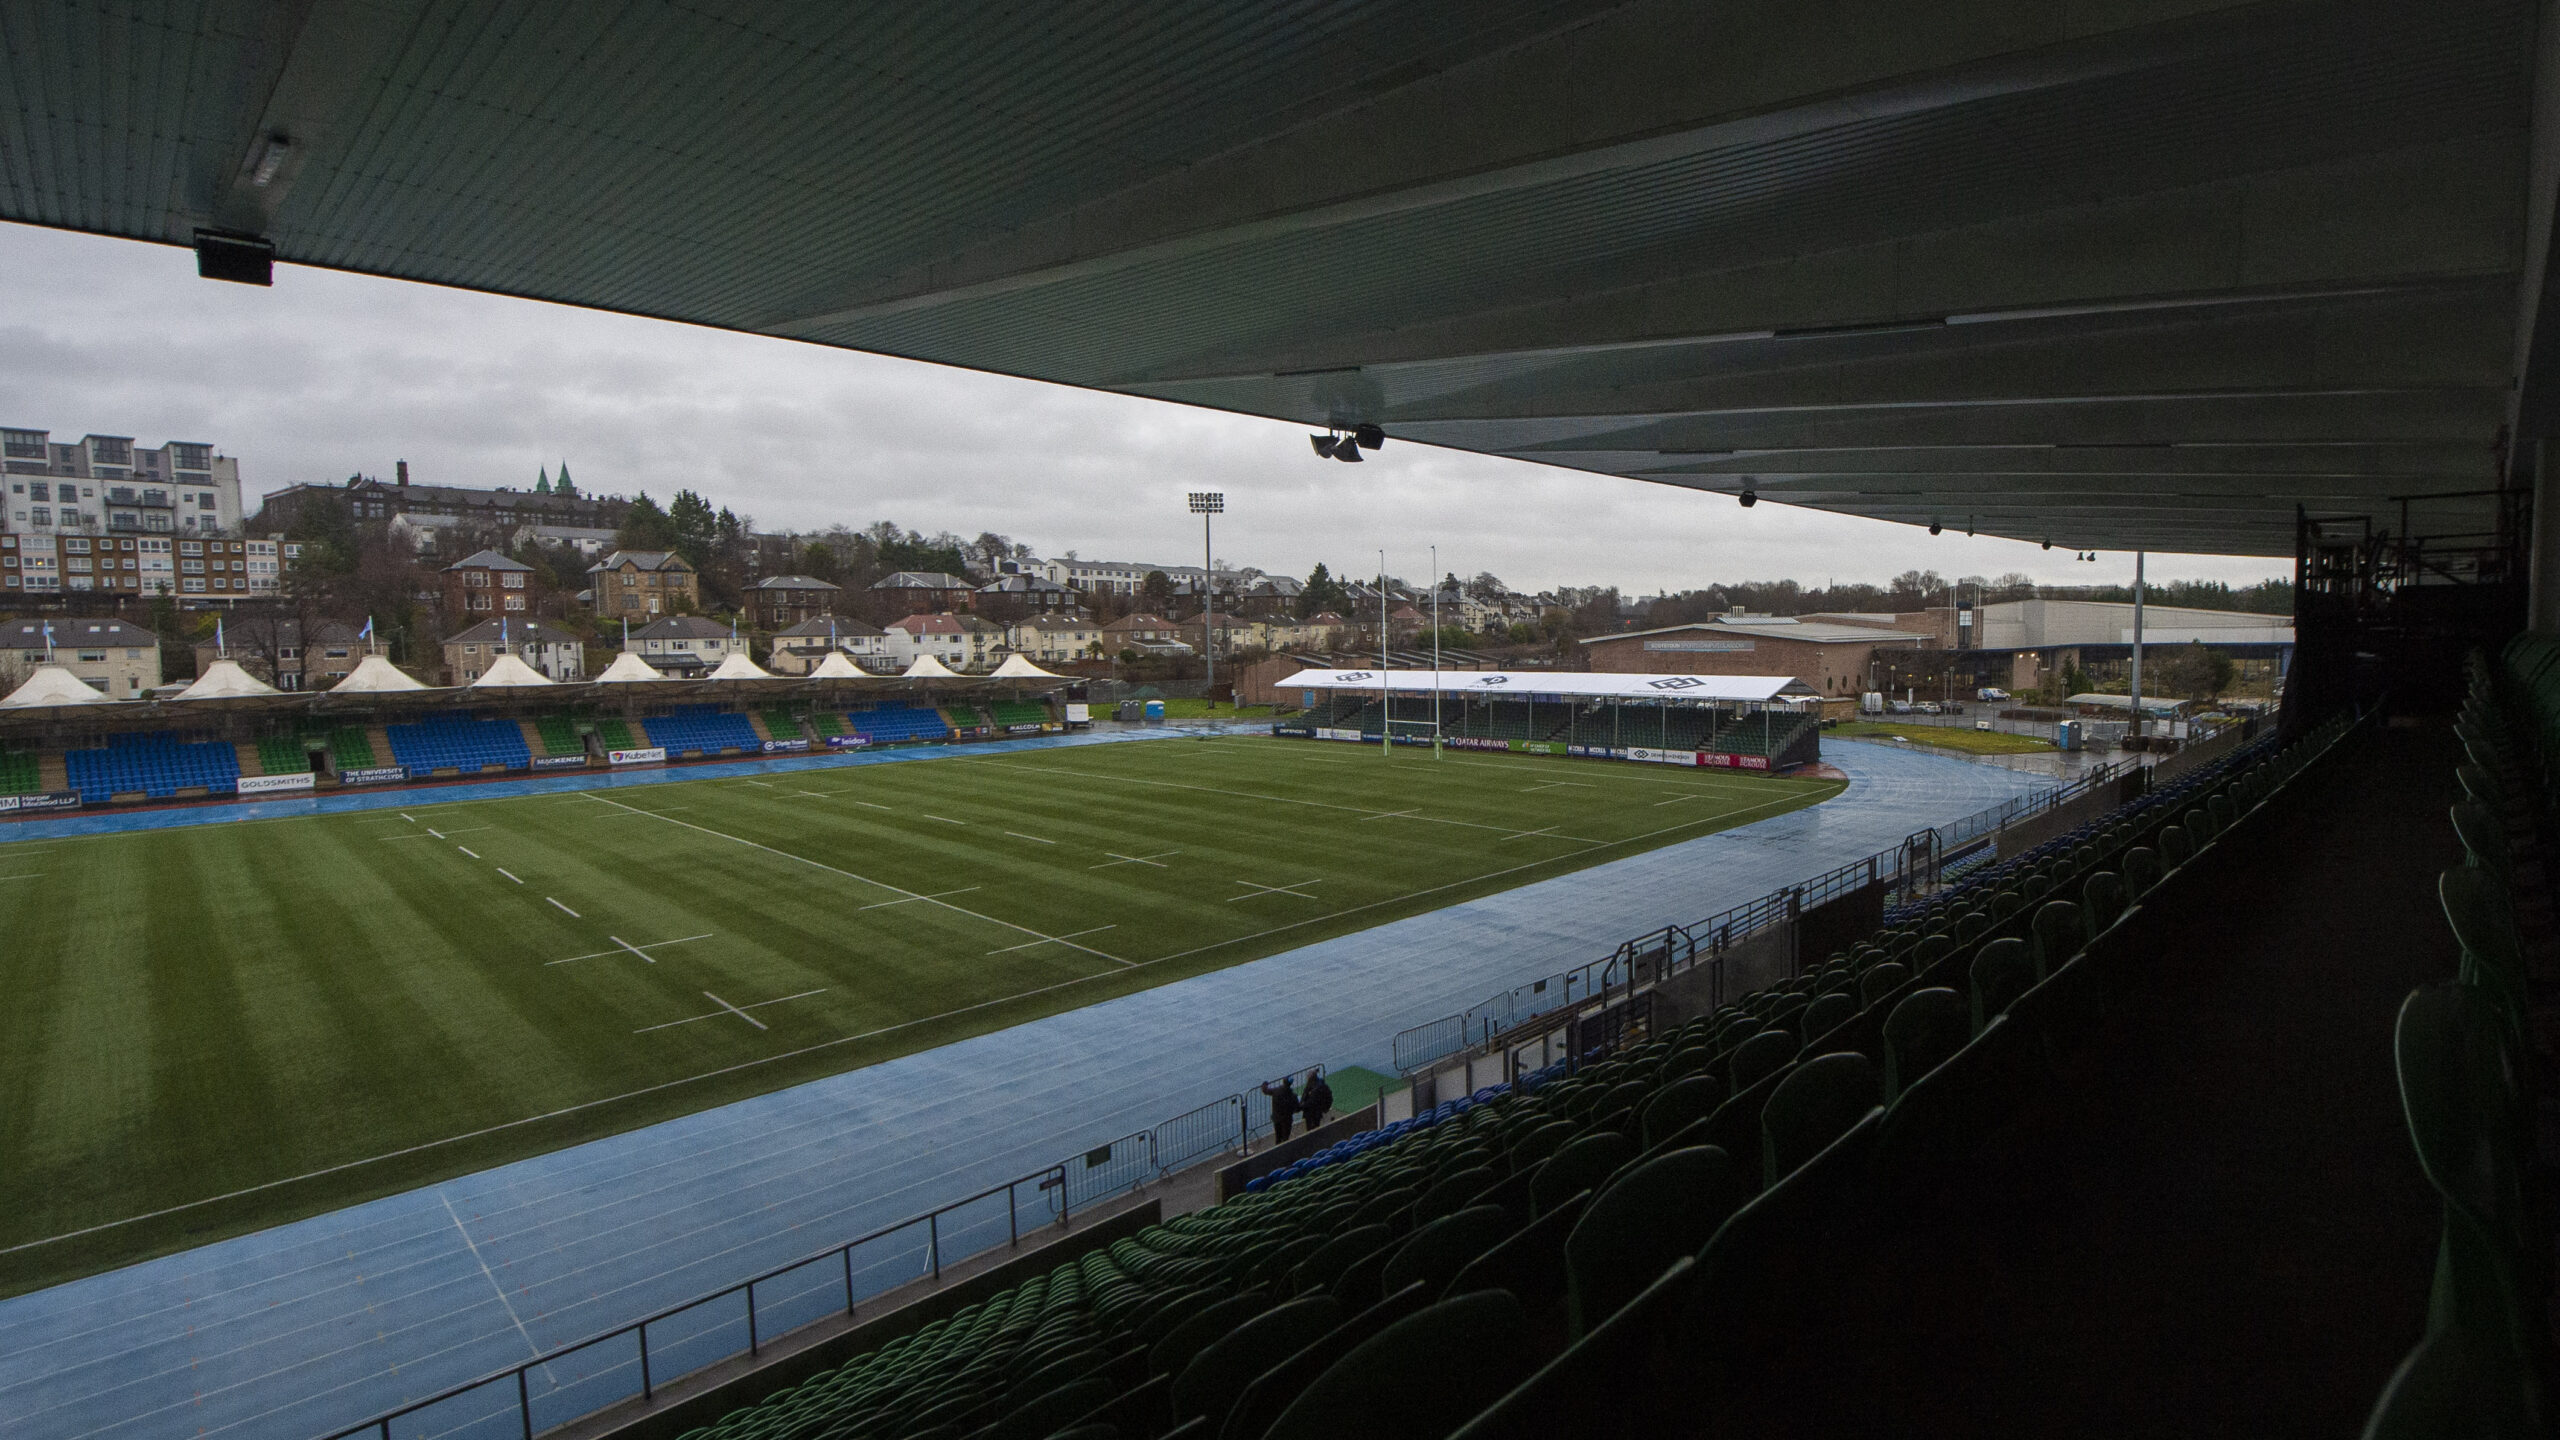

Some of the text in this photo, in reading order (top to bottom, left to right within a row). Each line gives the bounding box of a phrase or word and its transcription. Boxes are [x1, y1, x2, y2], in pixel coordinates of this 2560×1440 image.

[1456, 737, 1479, 746] QATAR
[1480, 739, 1509, 748] AIRWAYS
[624, 750, 662, 760] KubeNet
[536, 756, 585, 765] MACKENZIE
[360, 767, 403, 776] UNIVERSITY
[241, 777, 311, 788] GOLDSMITHS
[356, 773, 404, 783] STRATHCLYDE
